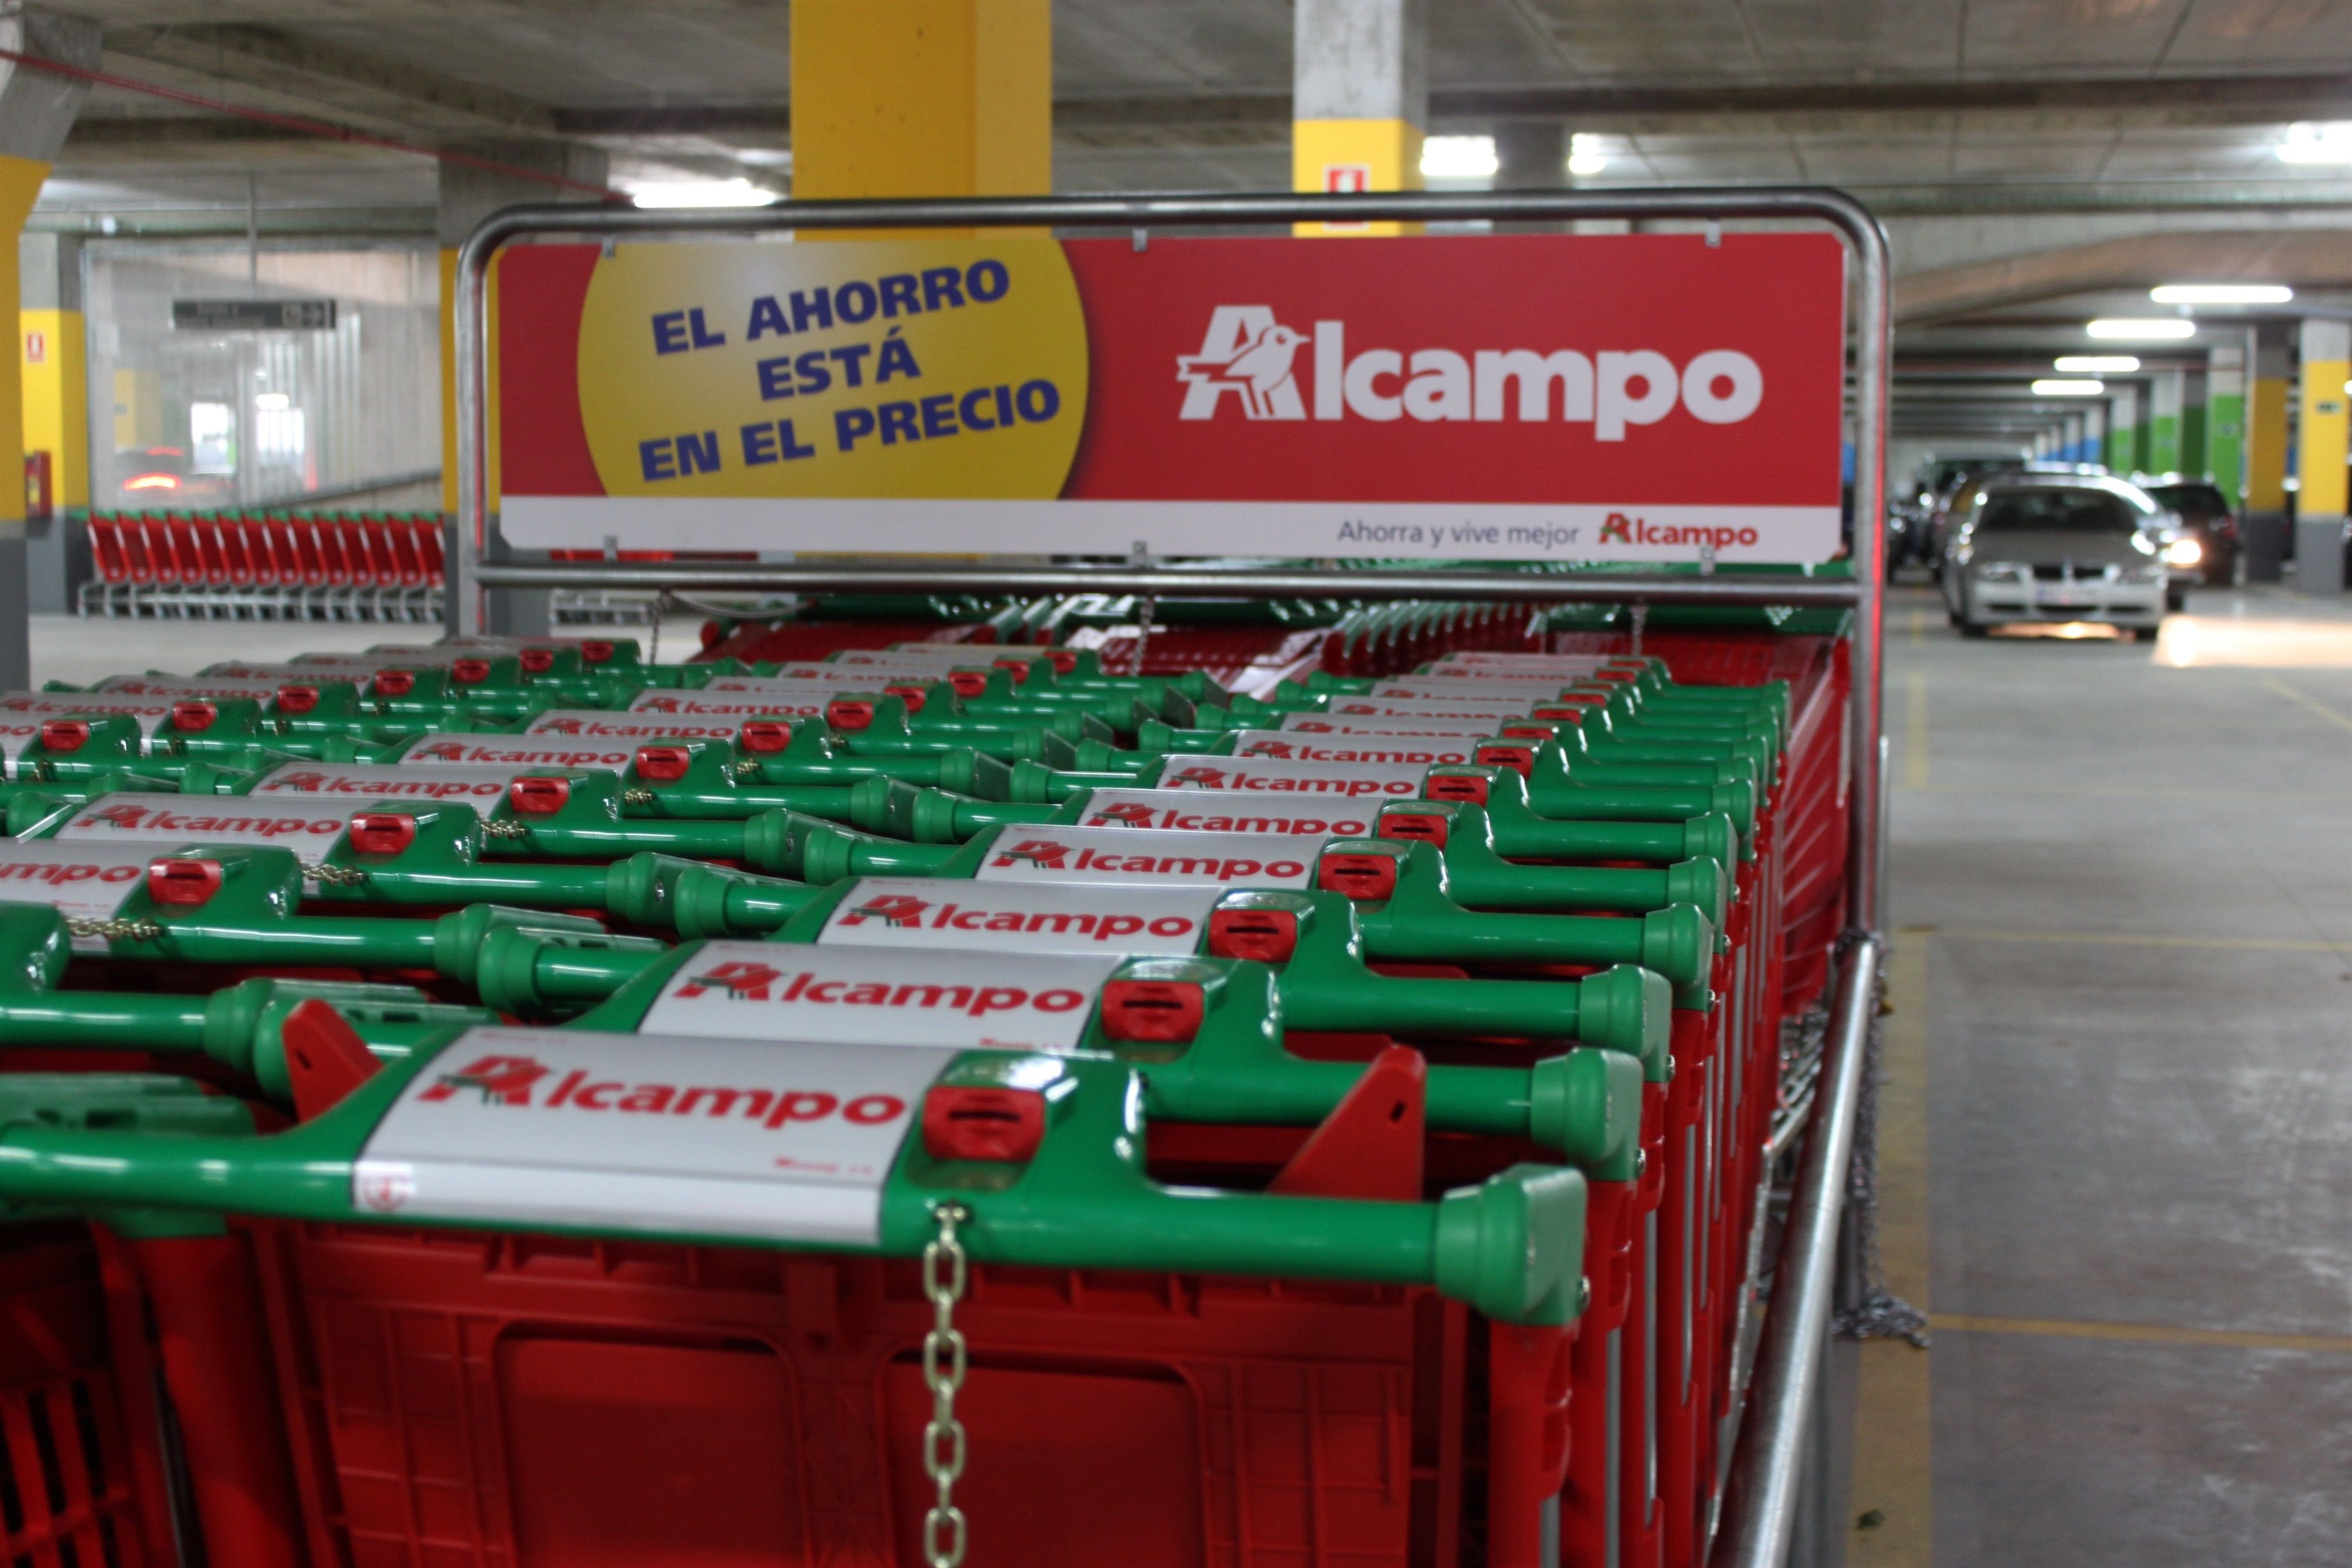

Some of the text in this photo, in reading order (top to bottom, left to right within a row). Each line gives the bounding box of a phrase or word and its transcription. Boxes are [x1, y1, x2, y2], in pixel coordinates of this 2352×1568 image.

[652, 259, 1009, 355] EL AHORRO
[757, 327, 921, 400] ESTÁ
[1176, 305, 1763, 442] Alcampo
[639, 379, 1060, 481] EN EL PRECIO
[1337, 512, 1759, 551] Ahorra y vive mejor Alcampo
[634, 697, 820, 716] Alcampo
[534, 718, 734, 739] Alcampo
[410, 742, 629, 768] Alcampo
[1239, 740, 1466, 764] Alcampo
[260, 771, 503, 799] Alcampo
[1163, 767, 1415, 798] Alcampo
[76, 804, 343, 837] Alcampo
[1088, 801, 1367, 836] Alcampo
[0, 863, 140, 886] mpo
[988, 840, 1304, 881] Alcampo
[838, 894, 1195, 942] Alcampo
[673, 961, 1086, 1018] Alcampo
[416, 1054, 907, 1131] Alcampo
